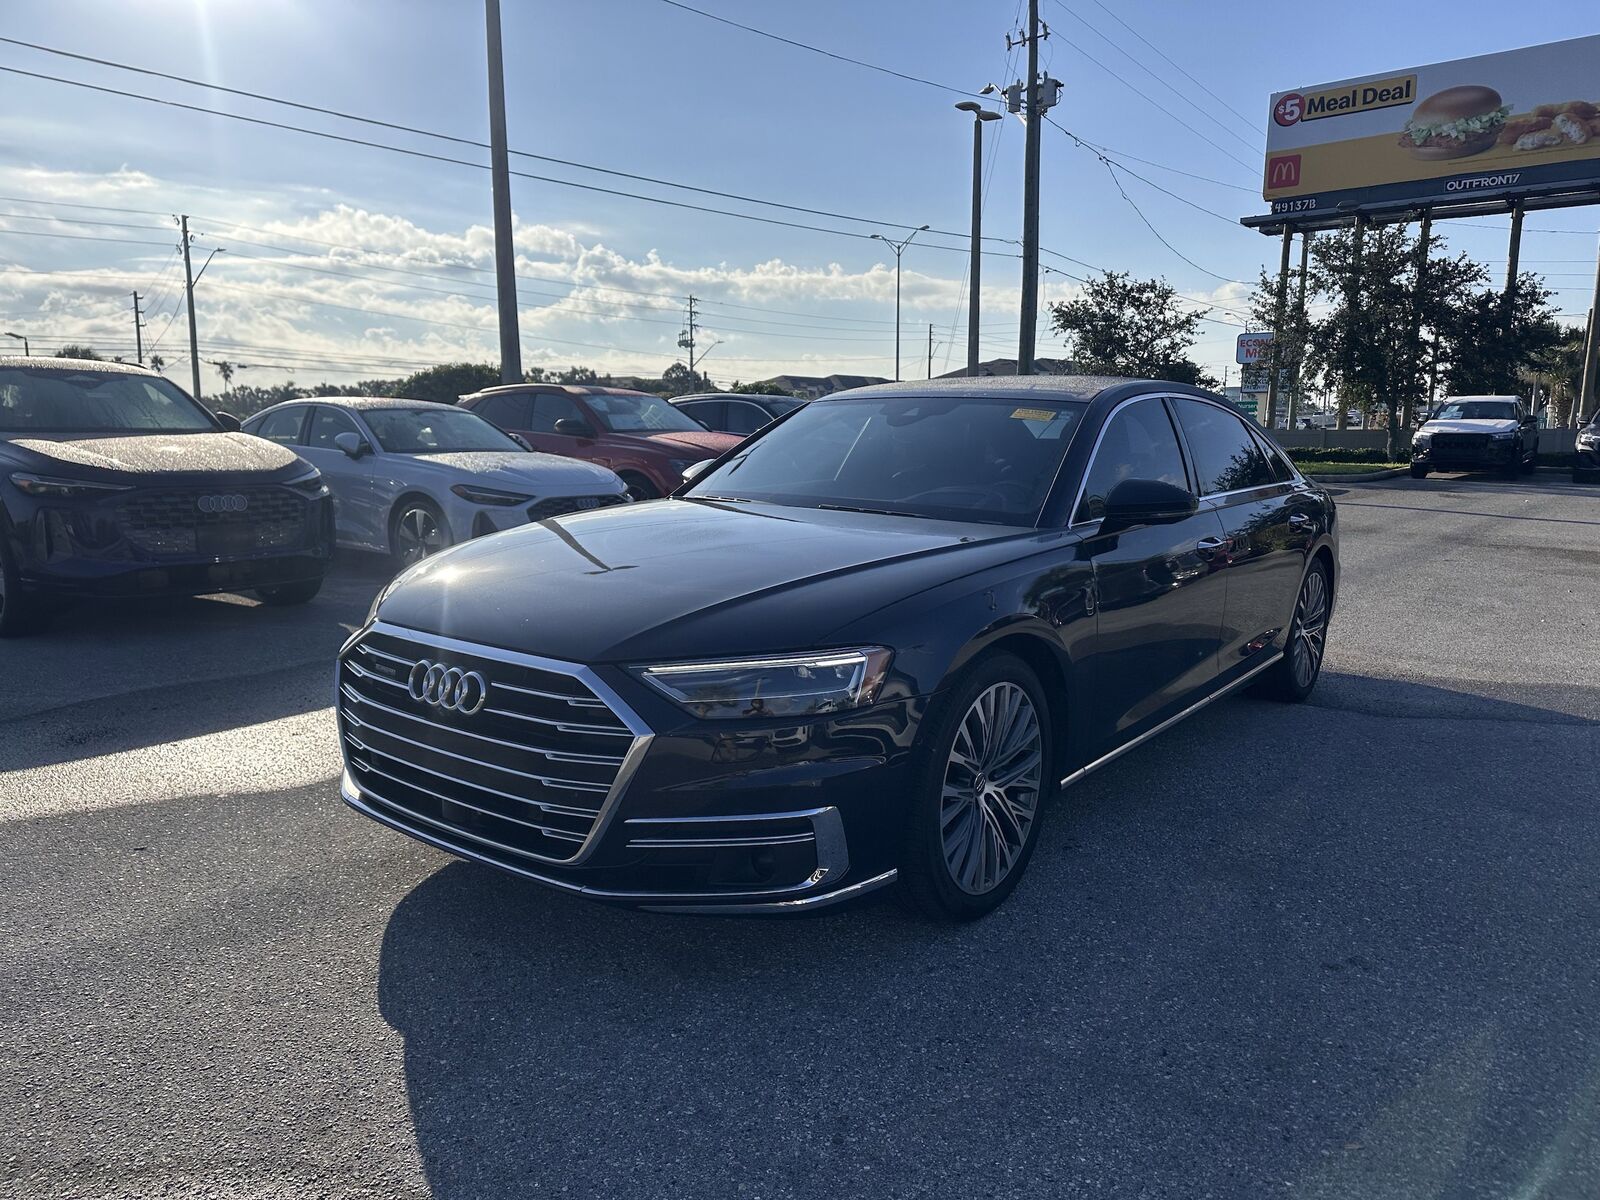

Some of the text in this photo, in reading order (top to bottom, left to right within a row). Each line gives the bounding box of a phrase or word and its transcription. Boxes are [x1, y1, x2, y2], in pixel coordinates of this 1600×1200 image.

[1277, 80, 1411, 120] $5 Meal Deal
[1274, 199, 1316, 213] 49137B
